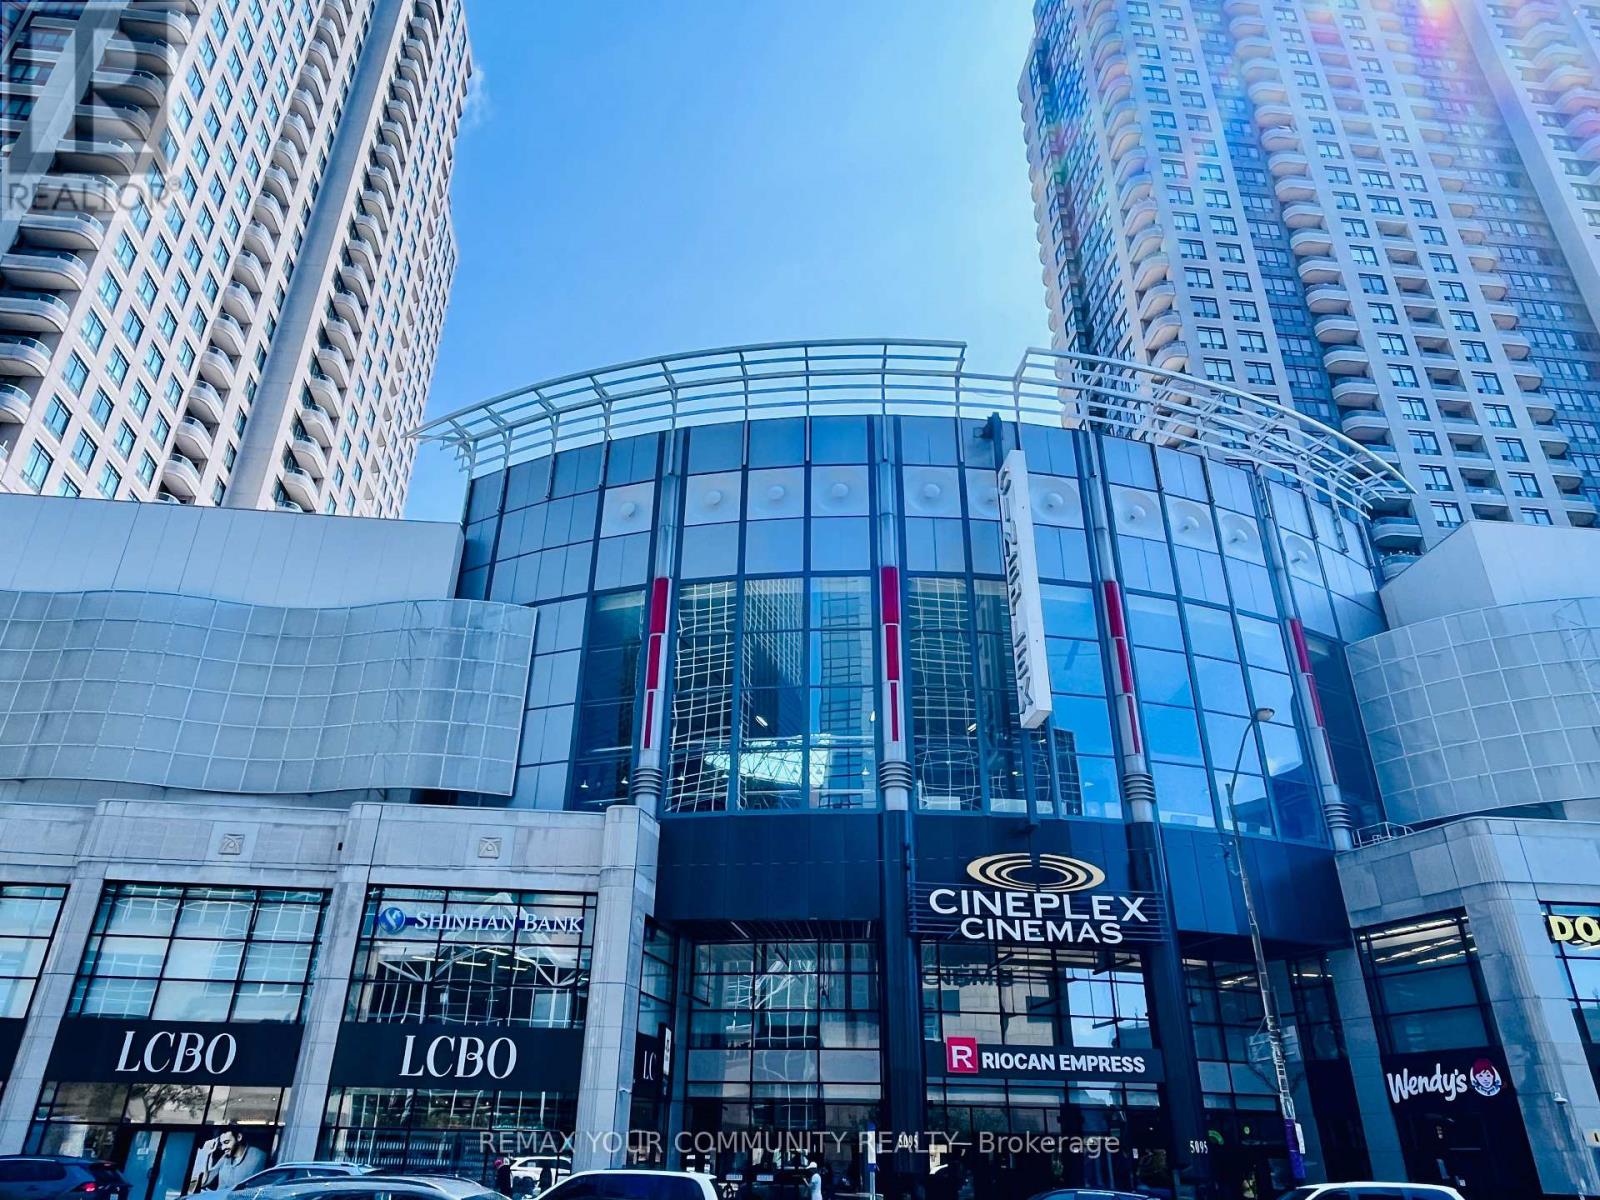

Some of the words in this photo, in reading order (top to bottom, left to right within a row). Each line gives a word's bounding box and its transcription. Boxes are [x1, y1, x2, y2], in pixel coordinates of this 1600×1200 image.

[929, 888, 1149, 922] CINEPLEX
[414, 911, 517, 931] SHINHAN
[522, 913, 583, 933] BANK
[960, 917, 1123, 944] CINEMAS
[115, 1030, 237, 1074] LCBO
[398, 1034, 517, 1079] LCBO
[951, 1046, 973, 1068] R
[982, 1051, 1055, 1071] RIOCAN
[1059, 1053, 1146, 1073] EMPRESS
[1386, 1063, 1468, 1103] Wendy's
[1189, 1140, 1208, 1154] 5095
